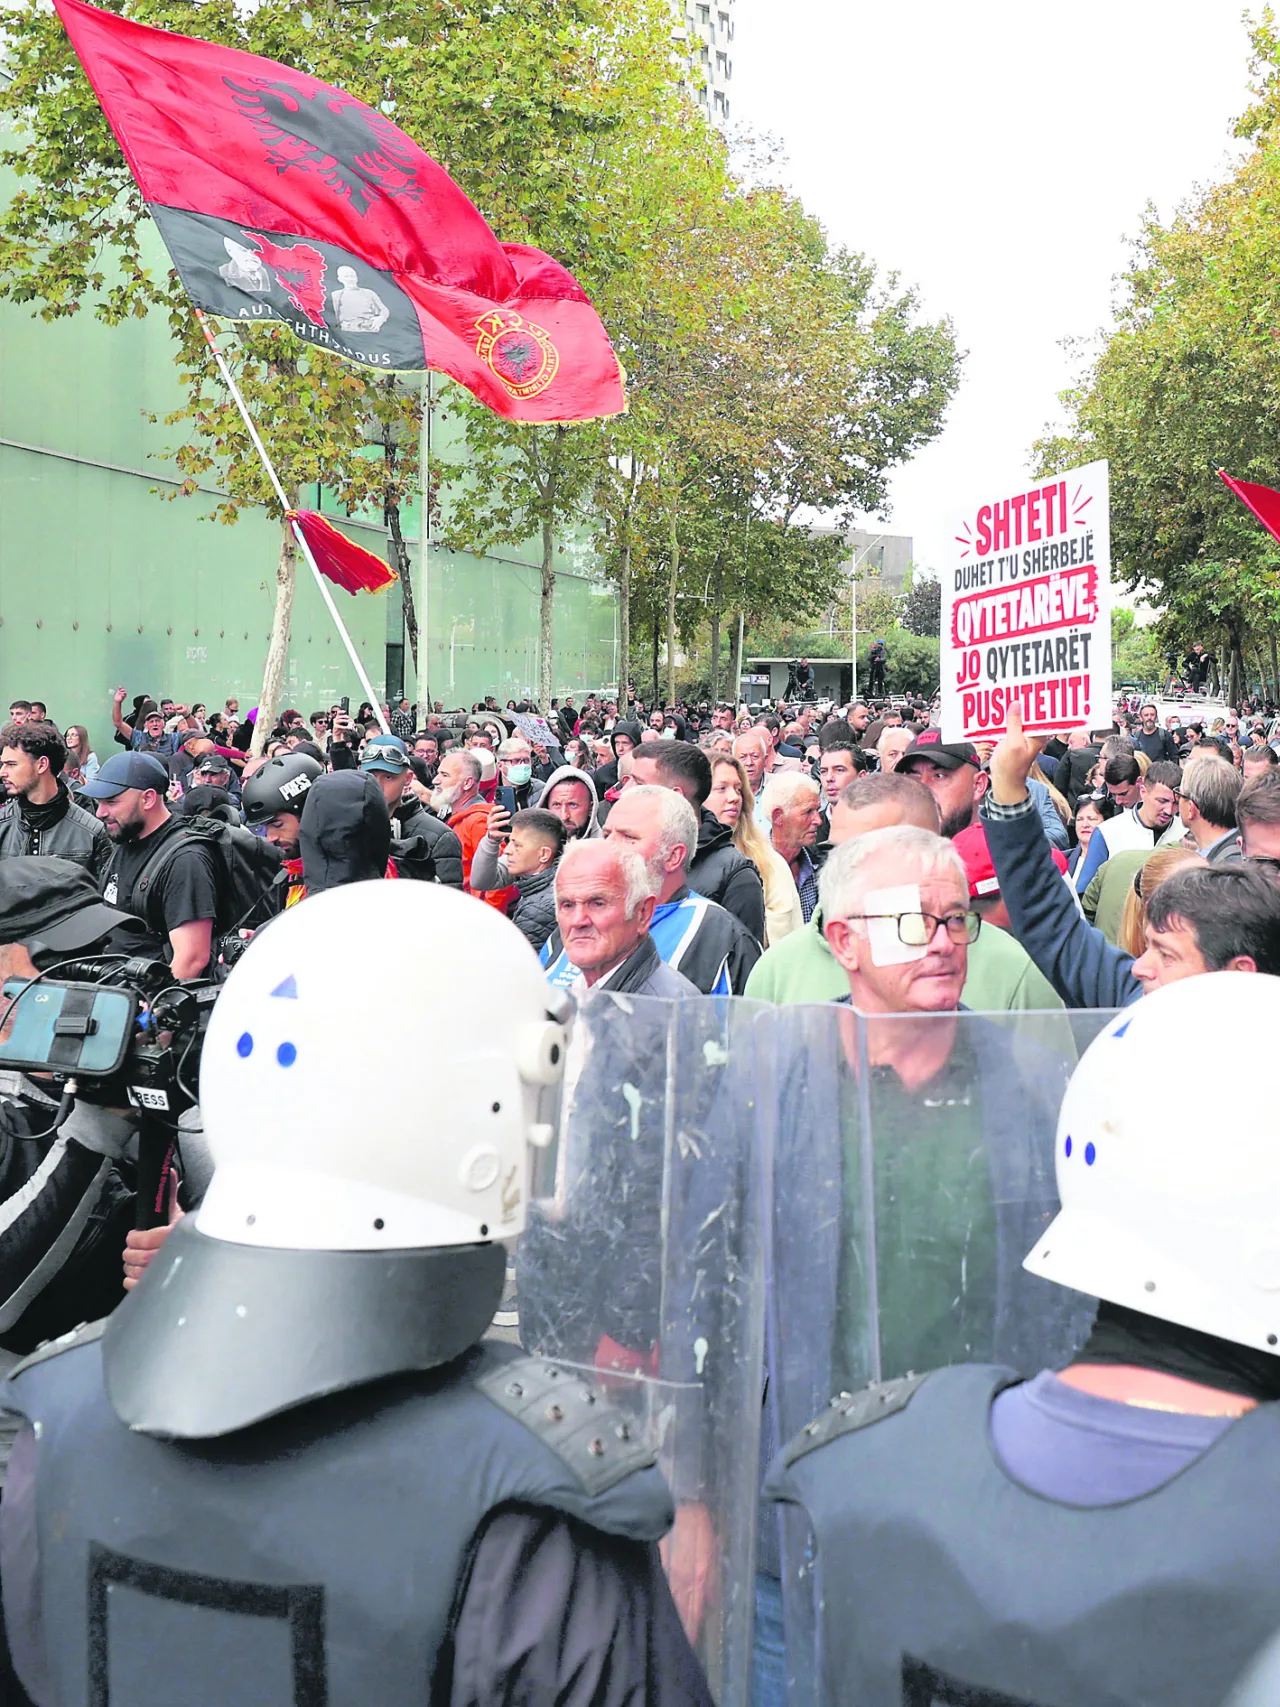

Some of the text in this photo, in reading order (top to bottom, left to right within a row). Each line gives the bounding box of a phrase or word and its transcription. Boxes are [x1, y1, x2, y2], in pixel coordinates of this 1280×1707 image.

[238, 303, 391, 365] AUTHTHOUS
[975, 481, 1067, 556] SHTETI
[954, 530, 1094, 592] DUHET T'U SHËRBEJË
[956, 573, 1095, 647] QYTETARËVE,
[956, 629, 1092, 684] JO QYTETARËT
[279, 772, 312, 801] PRESS
[131, 1090, 166, 1106] RESS
